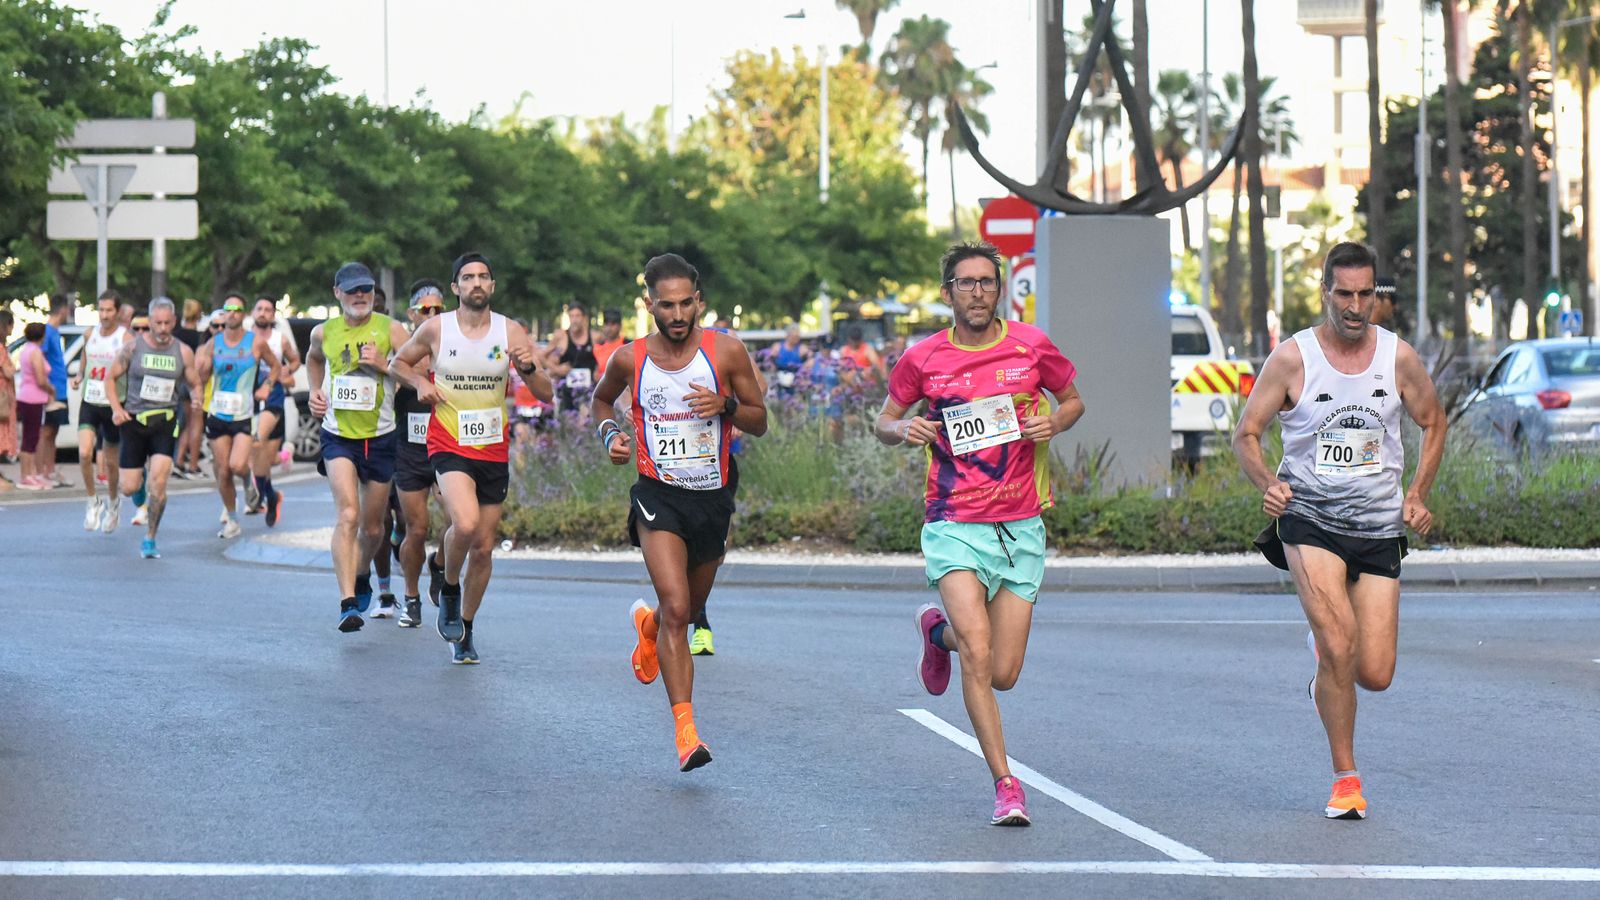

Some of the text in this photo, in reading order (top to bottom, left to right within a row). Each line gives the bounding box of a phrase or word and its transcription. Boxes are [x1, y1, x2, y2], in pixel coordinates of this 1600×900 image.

[144, 356, 174, 367] I RUN
[337, 387, 357, 400] 895
[947, 409, 960, 418] XXI
[1325, 405, 1364, 422] CARRERA
[463, 422, 485, 436] 169
[953, 418, 985, 440] 200
[658, 438, 686, 456] 211
[1322, 444, 1353, 463] 700
[676, 474, 709, 484] OYERÍAS
